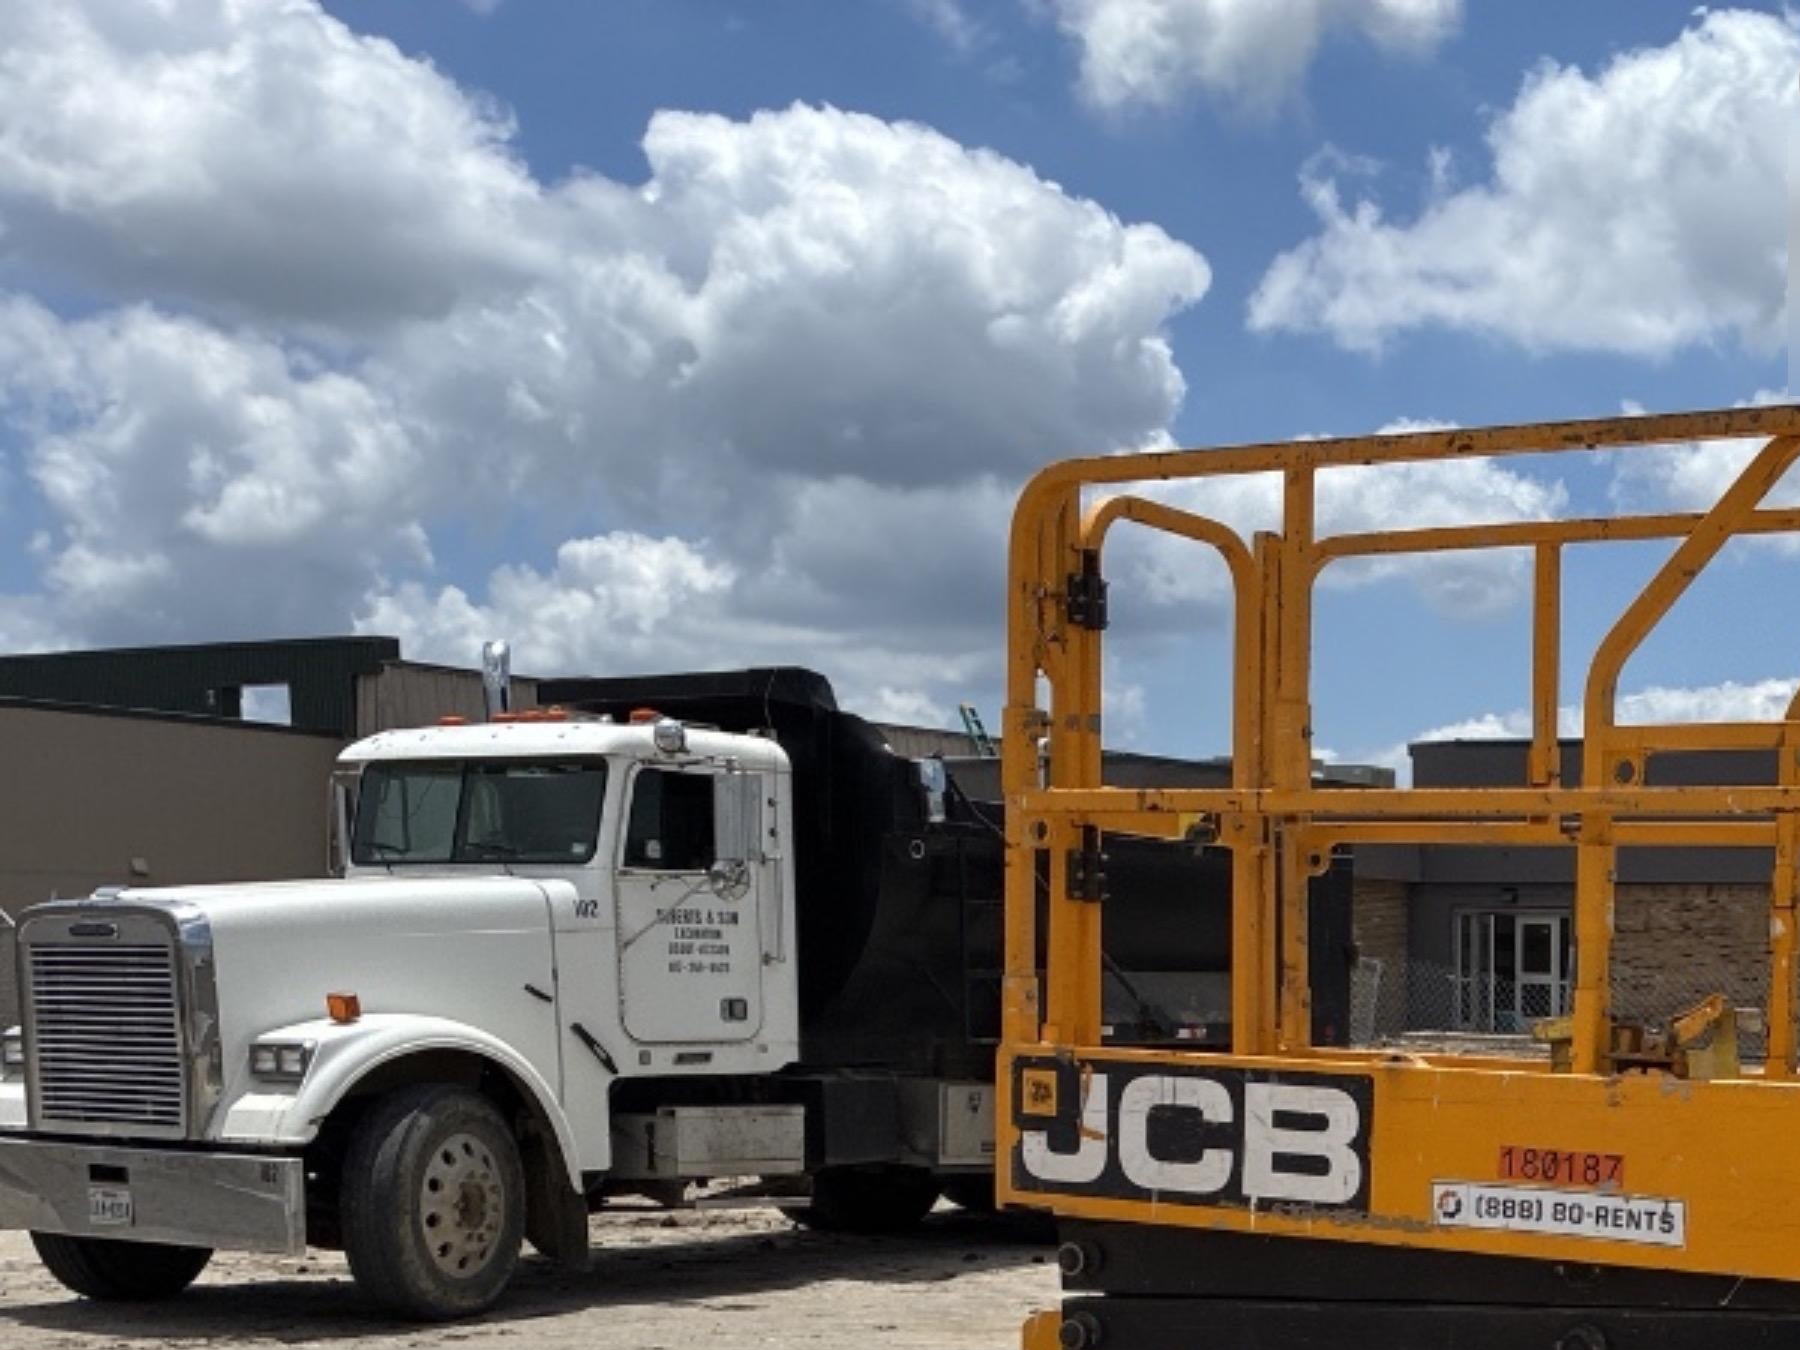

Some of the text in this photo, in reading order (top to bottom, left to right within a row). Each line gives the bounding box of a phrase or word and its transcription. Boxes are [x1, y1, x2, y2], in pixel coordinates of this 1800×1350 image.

[1021, 1072, 1363, 1204] JCB
[1502, 1147, 1624, 1185] 180187
[1475, 1194, 1544, 1222] (888)
